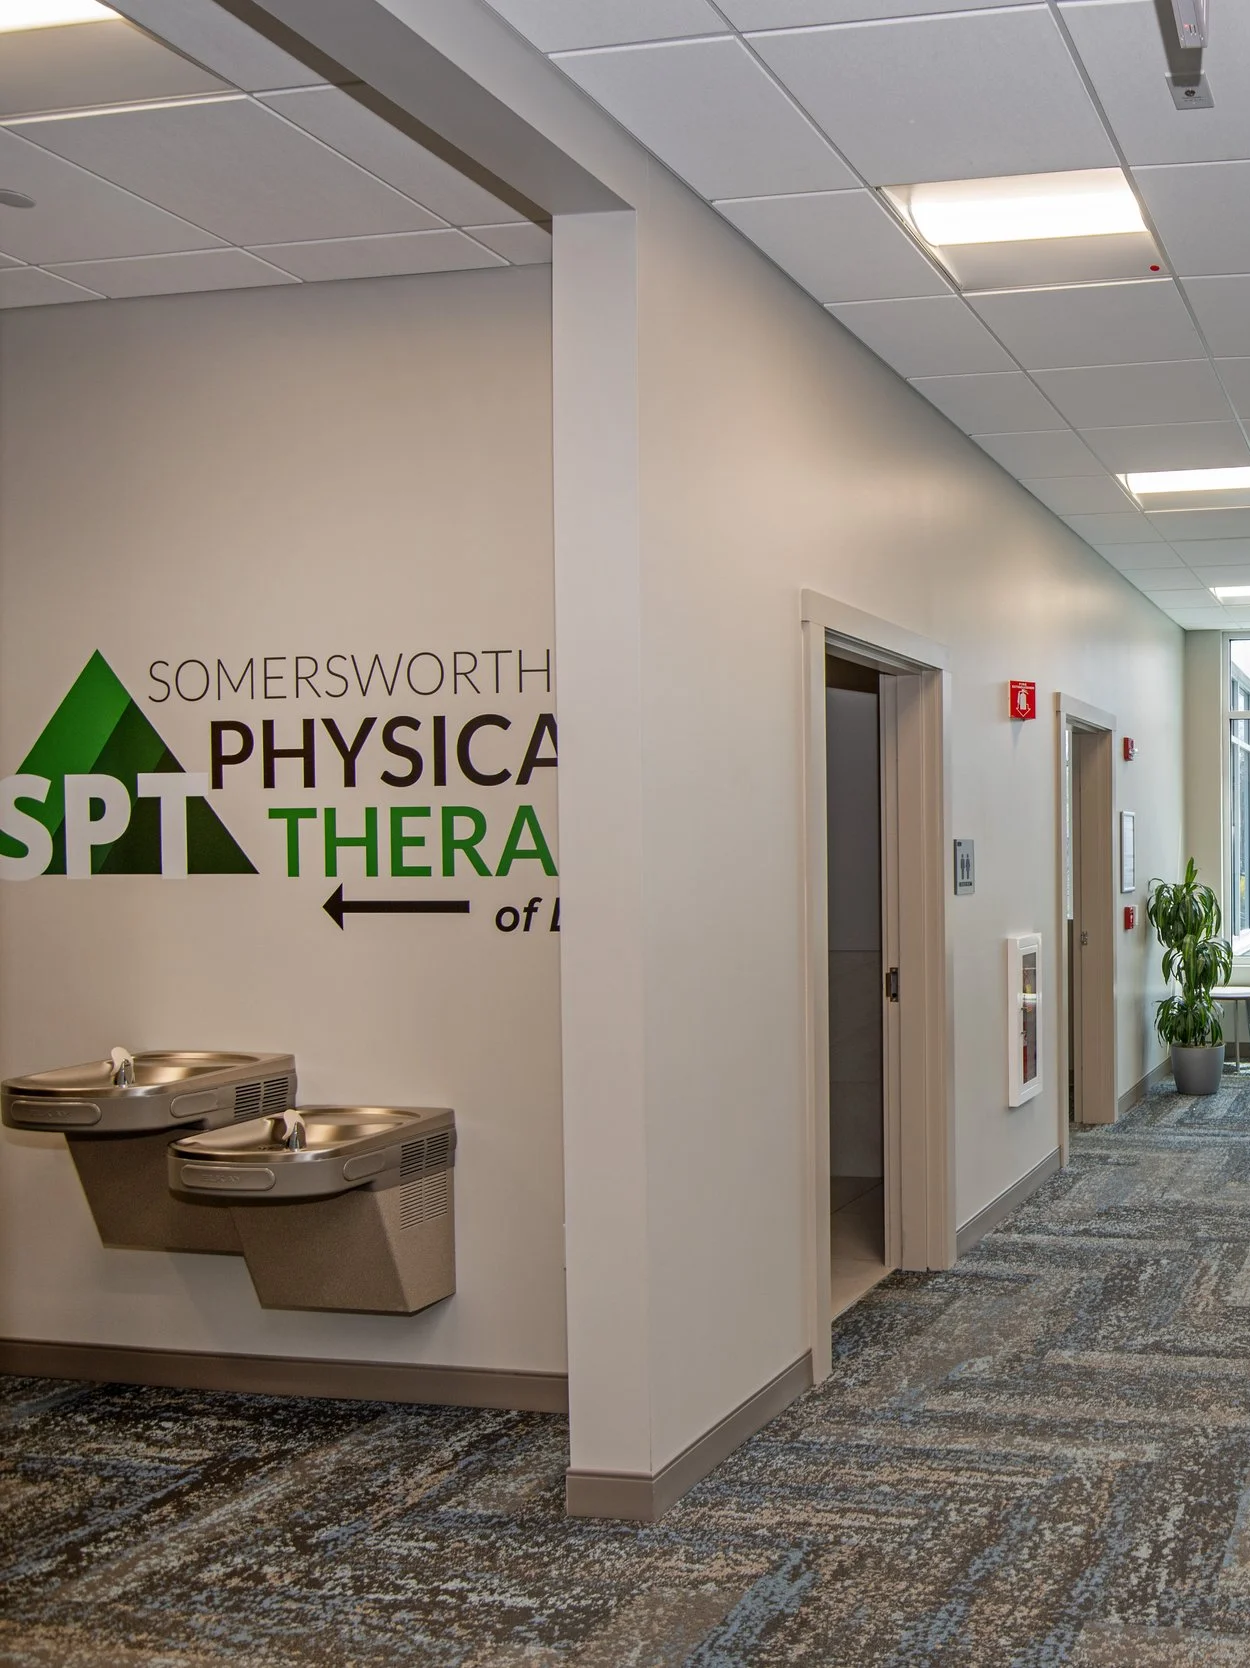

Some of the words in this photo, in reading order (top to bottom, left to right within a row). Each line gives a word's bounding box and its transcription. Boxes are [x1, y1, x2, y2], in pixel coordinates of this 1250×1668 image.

[148, 648, 551, 703] SOMERSWORTH
[210, 712, 558, 790] PHYSICA
[0, 772, 209, 882] SPT
[268, 804, 559, 878] THERA
[495, 896, 543, 933] of
